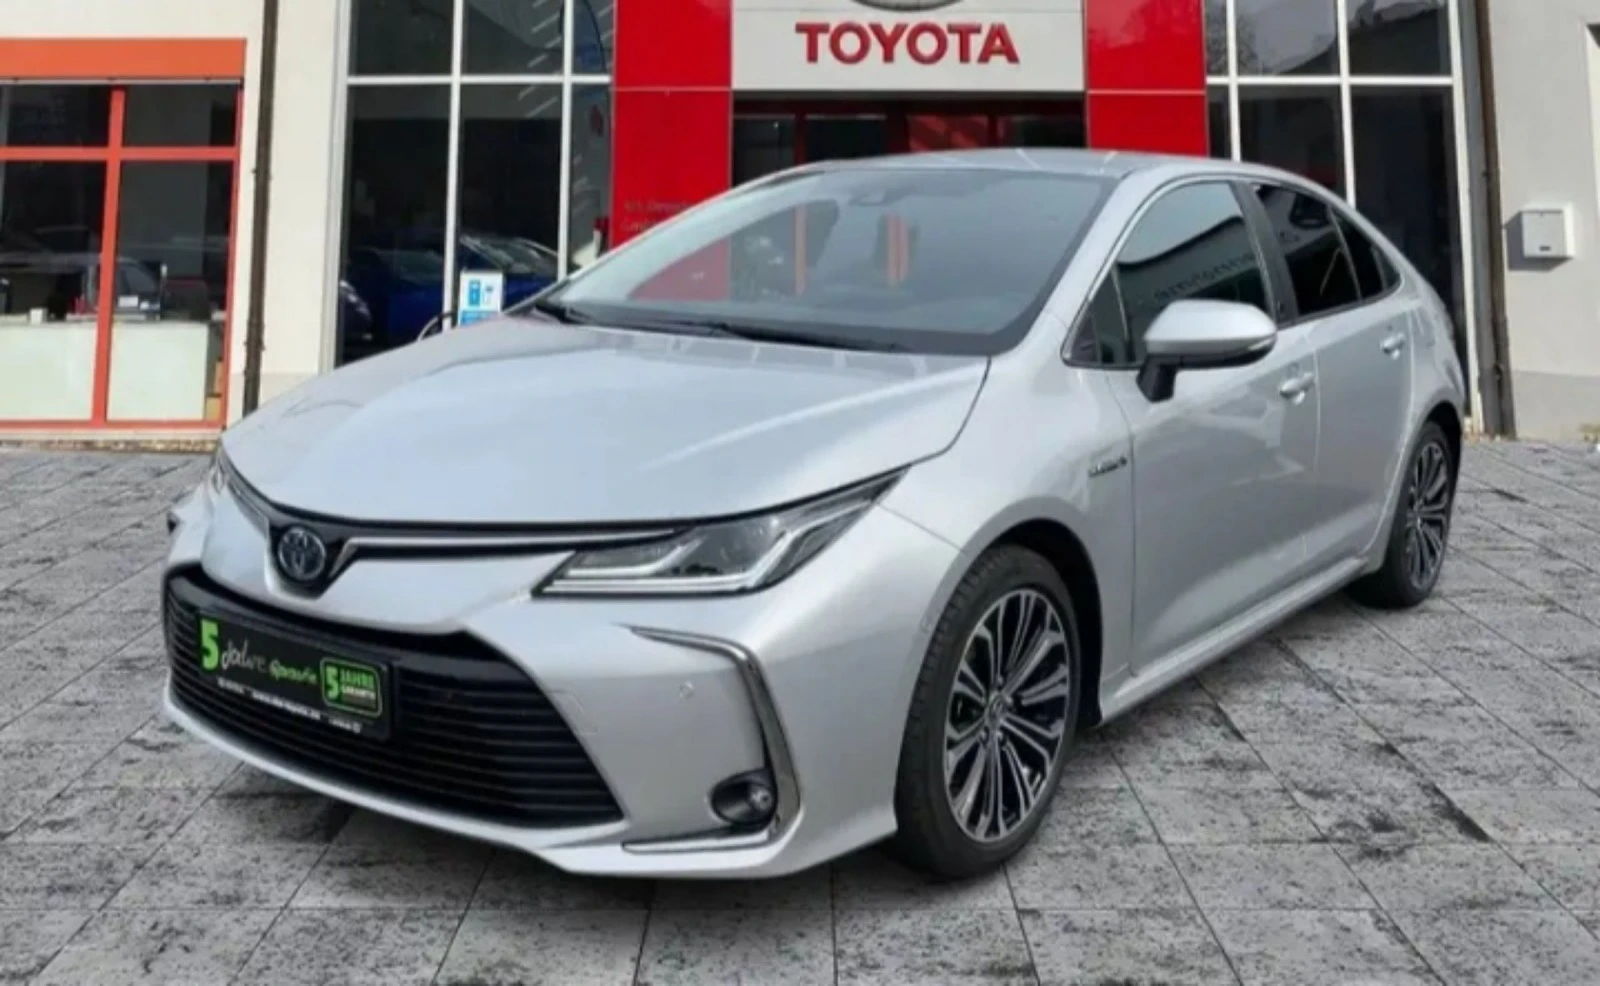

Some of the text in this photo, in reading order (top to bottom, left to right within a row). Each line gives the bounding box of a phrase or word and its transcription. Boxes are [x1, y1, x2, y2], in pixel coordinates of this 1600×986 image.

[795, 21, 1020, 65] TOYOTA
[201, 618, 219, 670] 5
[326, 665, 339, 699] 5
